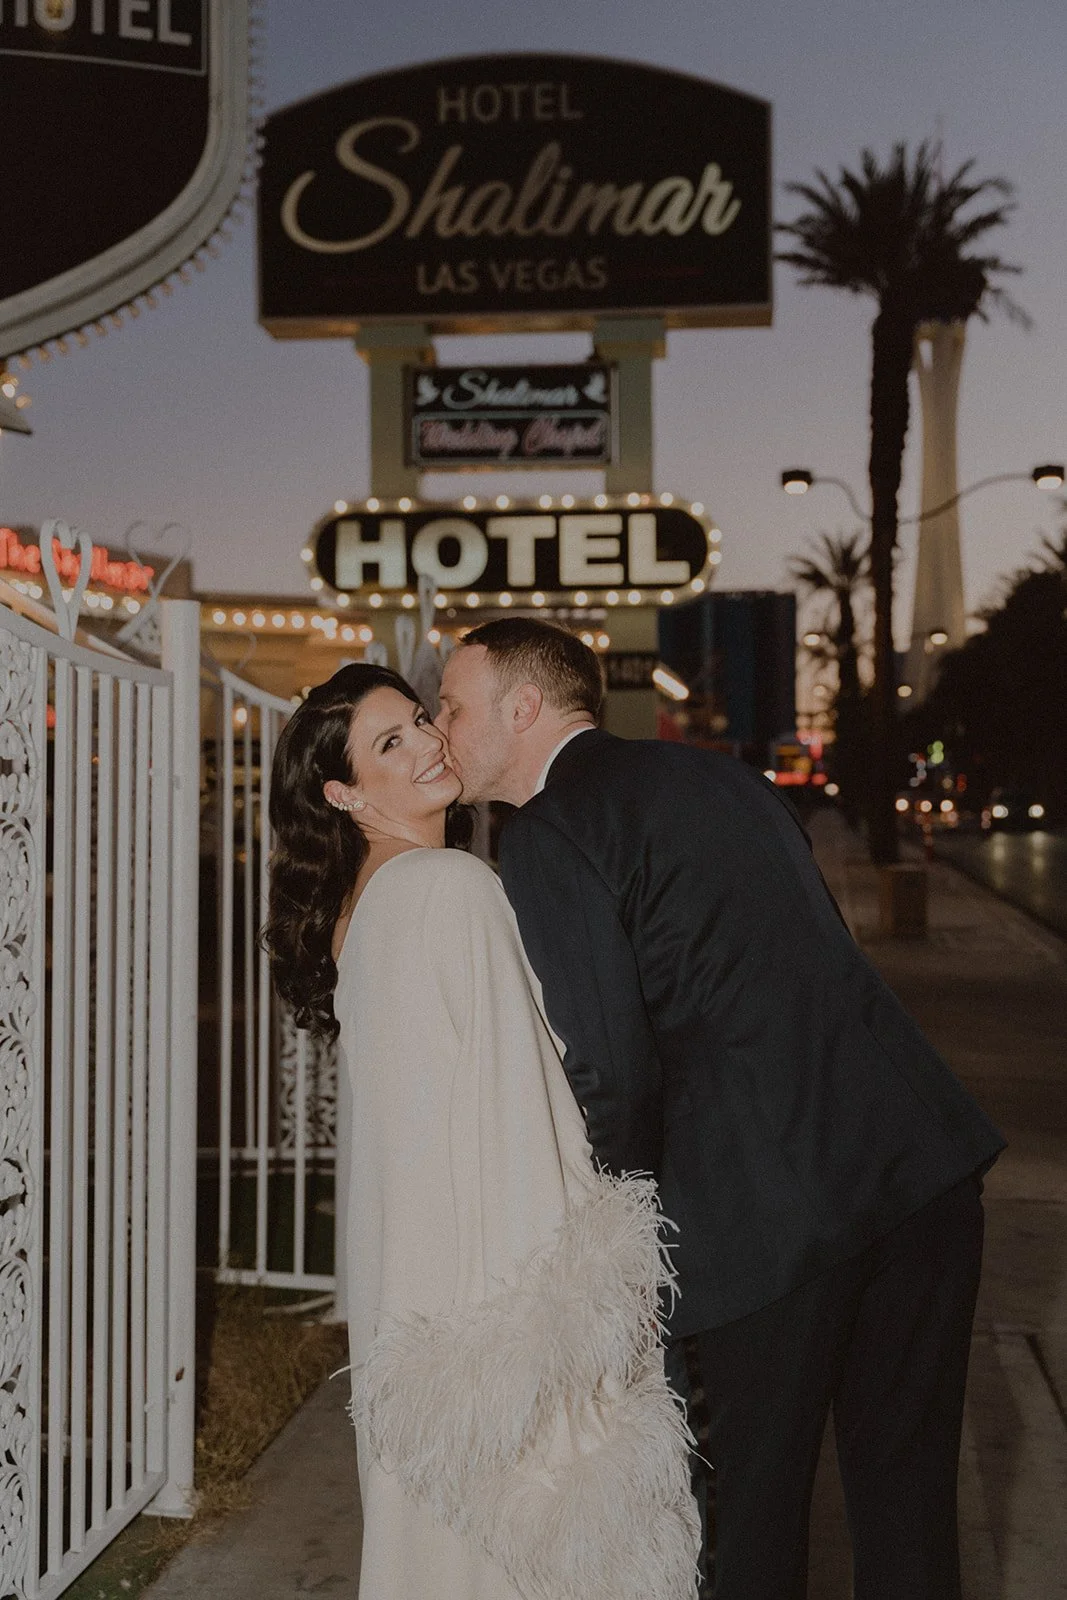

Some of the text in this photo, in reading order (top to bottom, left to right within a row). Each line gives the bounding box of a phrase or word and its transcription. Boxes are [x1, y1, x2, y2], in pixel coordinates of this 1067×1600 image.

[439, 82, 583, 122] HOTEL
[281, 116, 742, 254] Shalimar
[416, 258, 607, 294] LAS VEGAS
[335, 513, 690, 590] HOTEL
